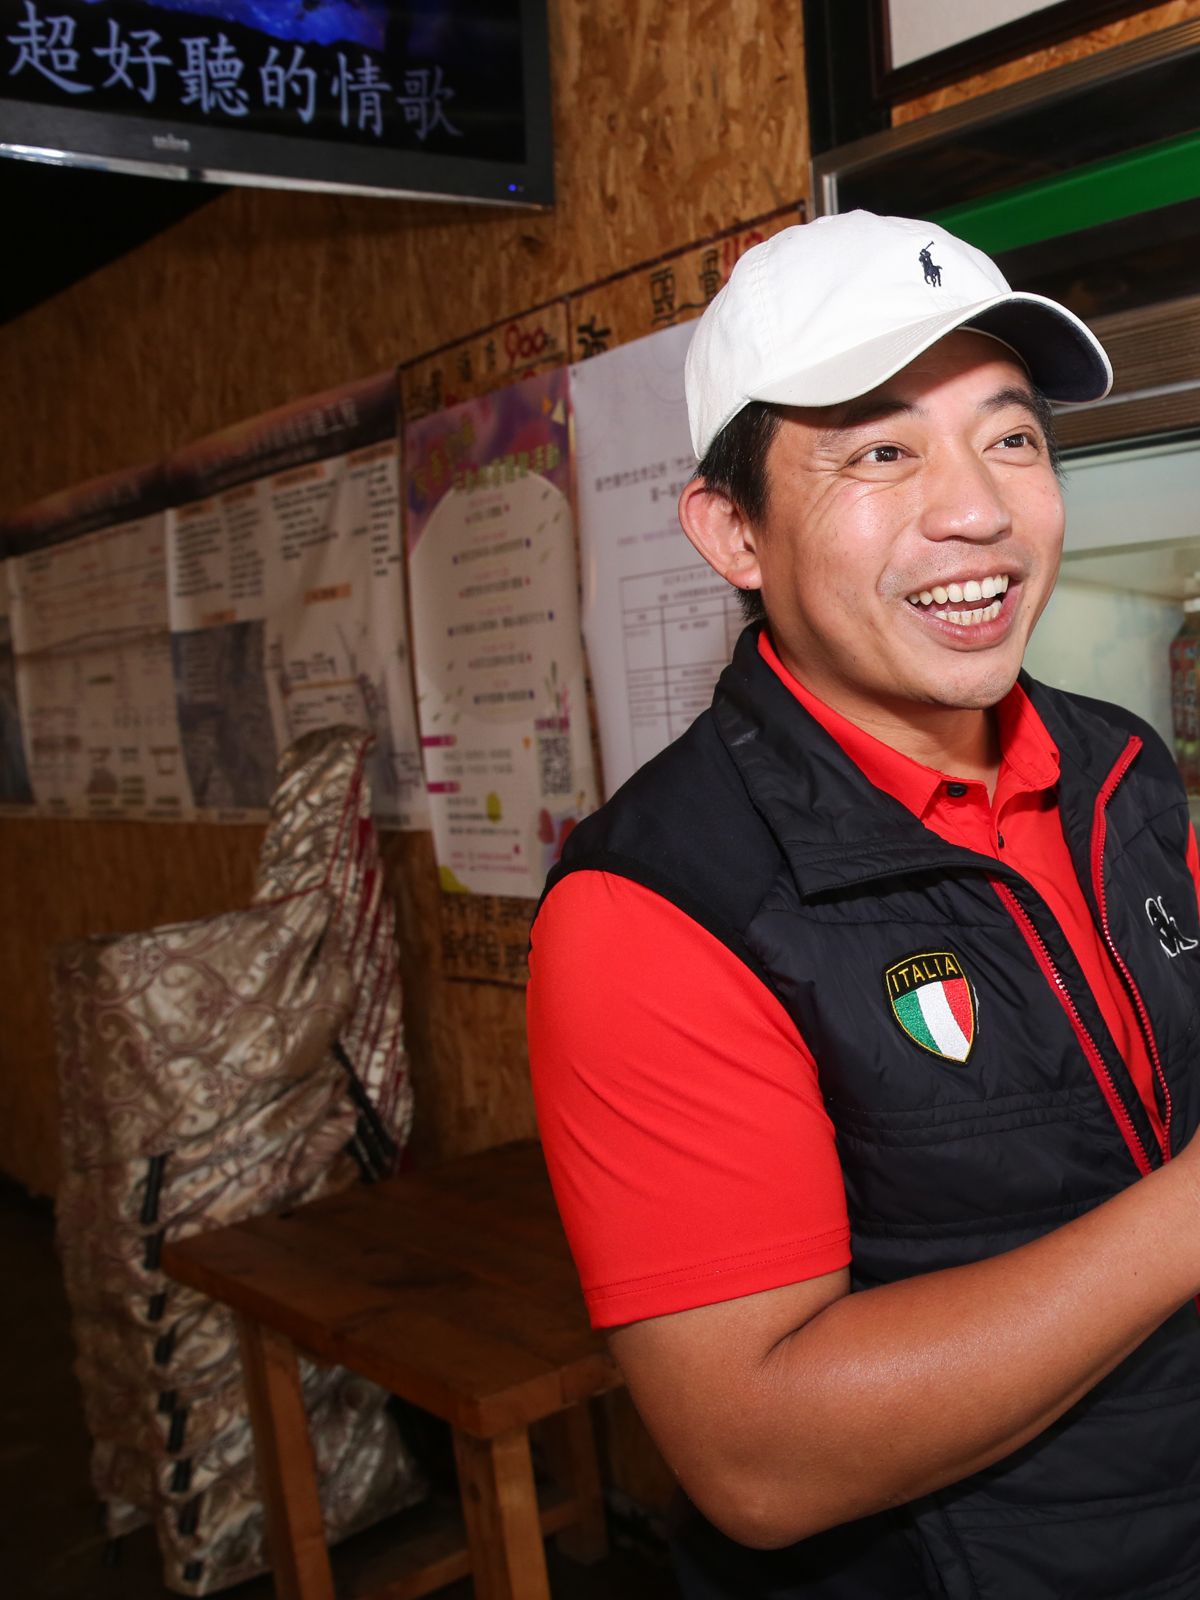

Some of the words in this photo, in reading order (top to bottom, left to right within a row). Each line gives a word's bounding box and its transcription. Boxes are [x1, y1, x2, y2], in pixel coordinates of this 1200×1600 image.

[7, 1, 464, 141] 超好聽的情歌
[890, 955, 959, 992] ITALIA
